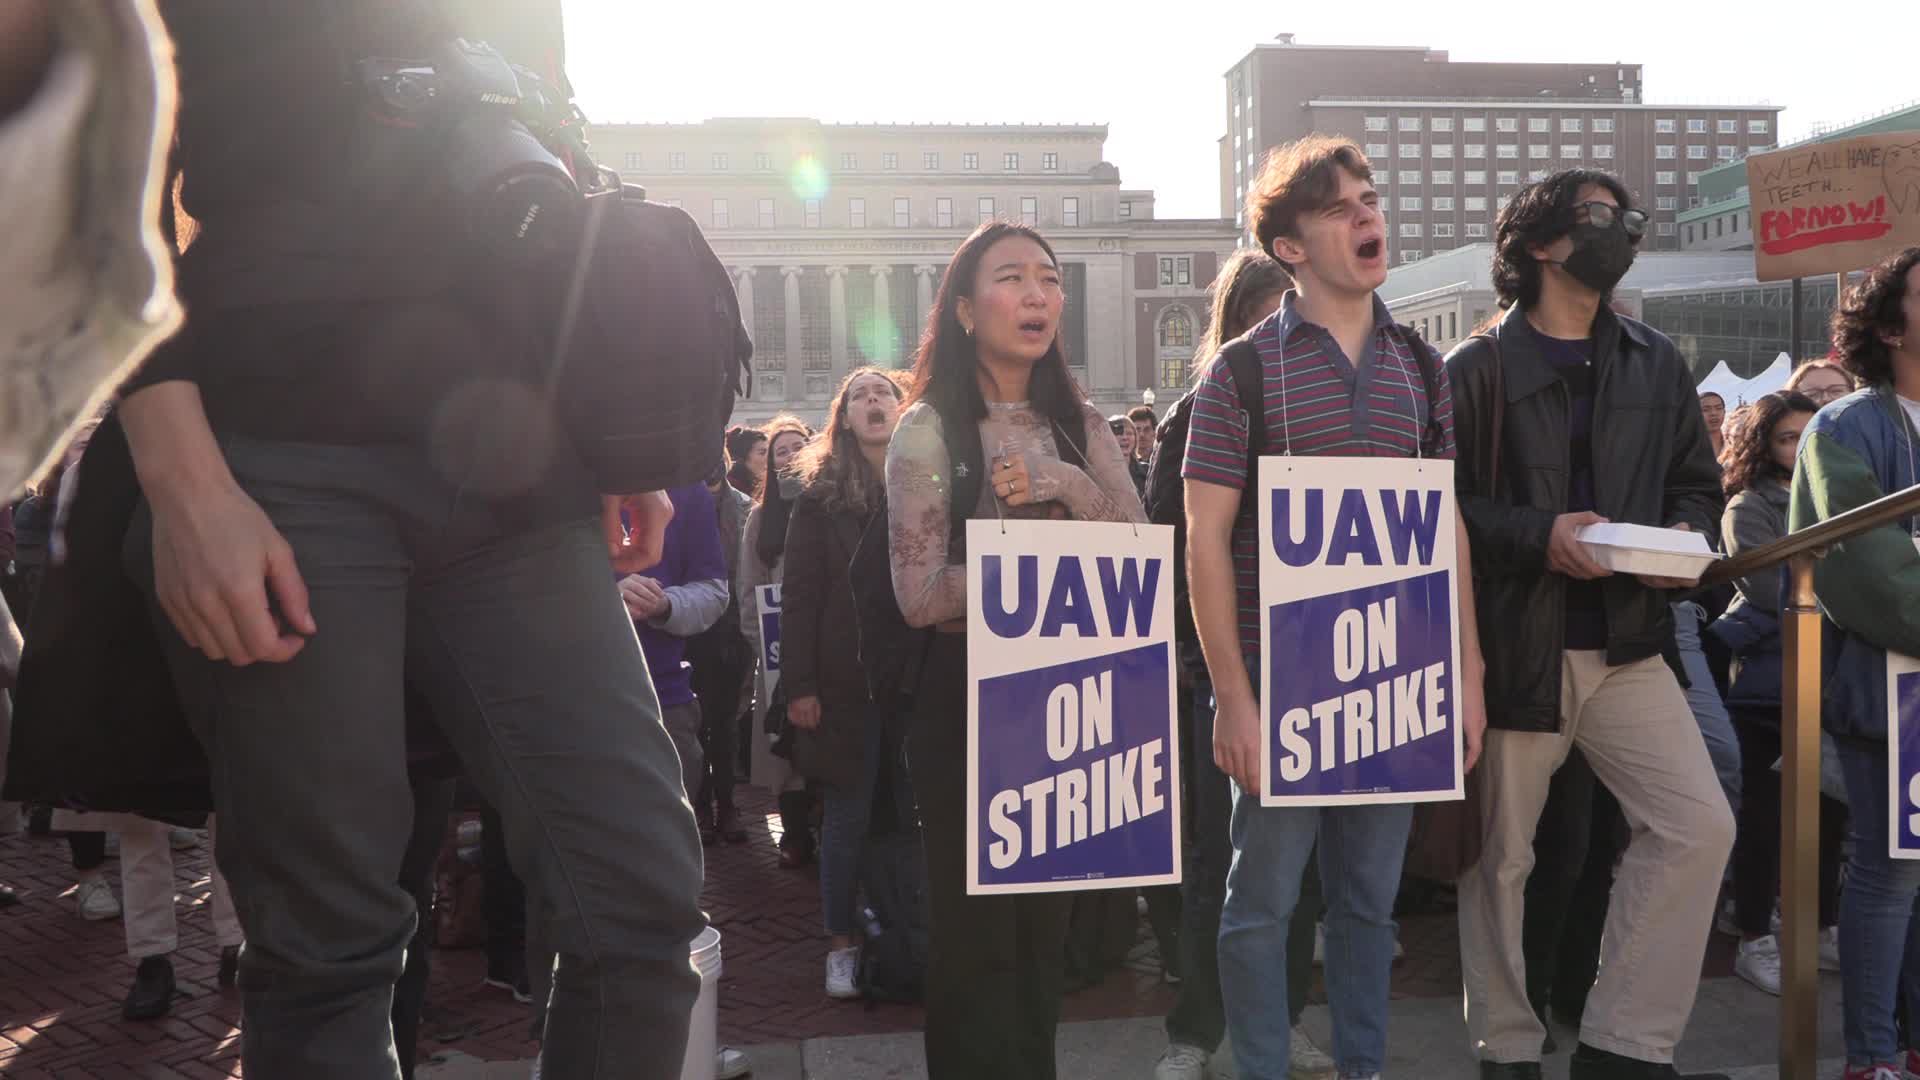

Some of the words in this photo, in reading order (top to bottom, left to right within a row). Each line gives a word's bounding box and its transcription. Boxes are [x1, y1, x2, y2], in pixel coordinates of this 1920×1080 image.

[480, 93, 518, 104] Nikon
[1754, 157, 1801, 185] WE
[1807, 151, 1841, 176] ALL
[1847, 147, 1881, 169] HAVE
[514, 202, 541, 238] Nikon
[1271, 488, 1442, 567] UAW
[981, 555, 1162, 638] UAW
[1333, 596, 1397, 683] ON
[1046, 670, 1112, 762] ON
[1279, 661, 1447, 782] STRIKE
[988, 737, 1164, 870] STRIKE
